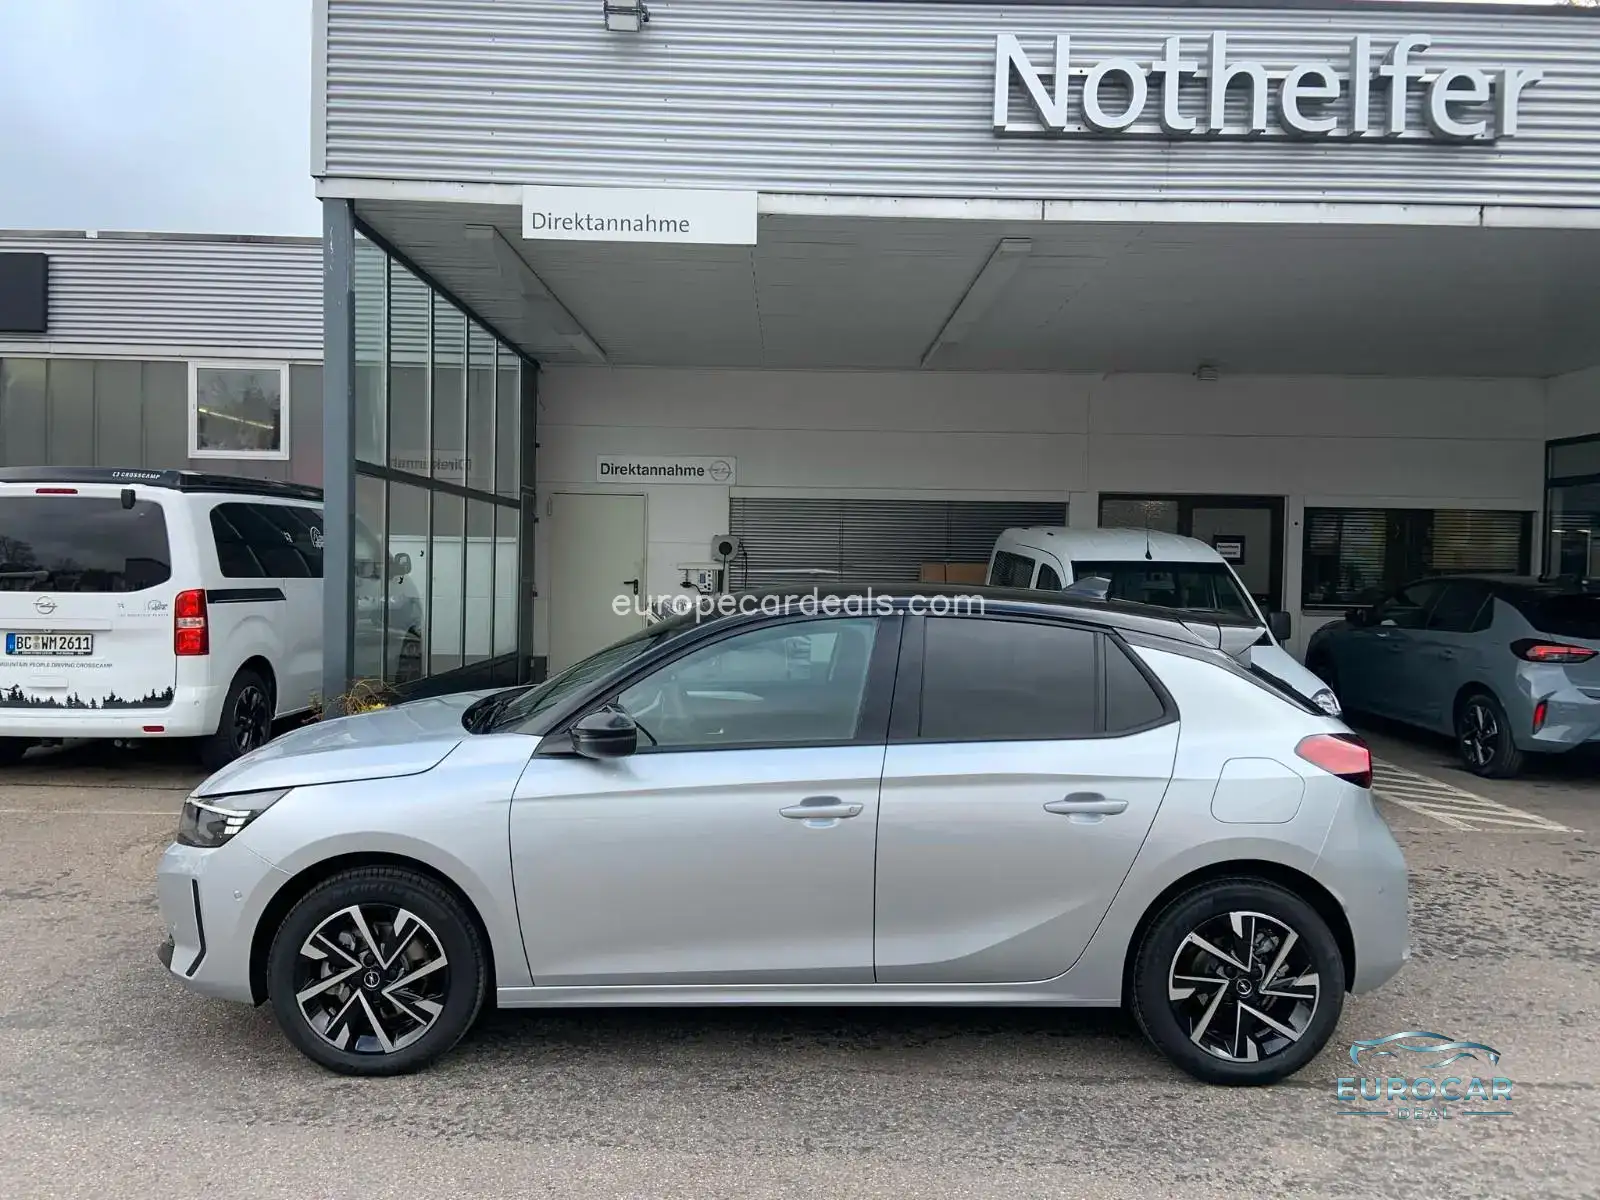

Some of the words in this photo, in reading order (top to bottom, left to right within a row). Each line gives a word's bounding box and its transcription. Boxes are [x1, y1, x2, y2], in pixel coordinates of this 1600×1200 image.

[993, 31, 1543, 138] Nothelfer
[531, 212, 691, 233] Direktannahme
[599, 462, 705, 476] Direktannahme
[16, 636, 32, 650] BC
[59, 636, 91, 650] 2611
